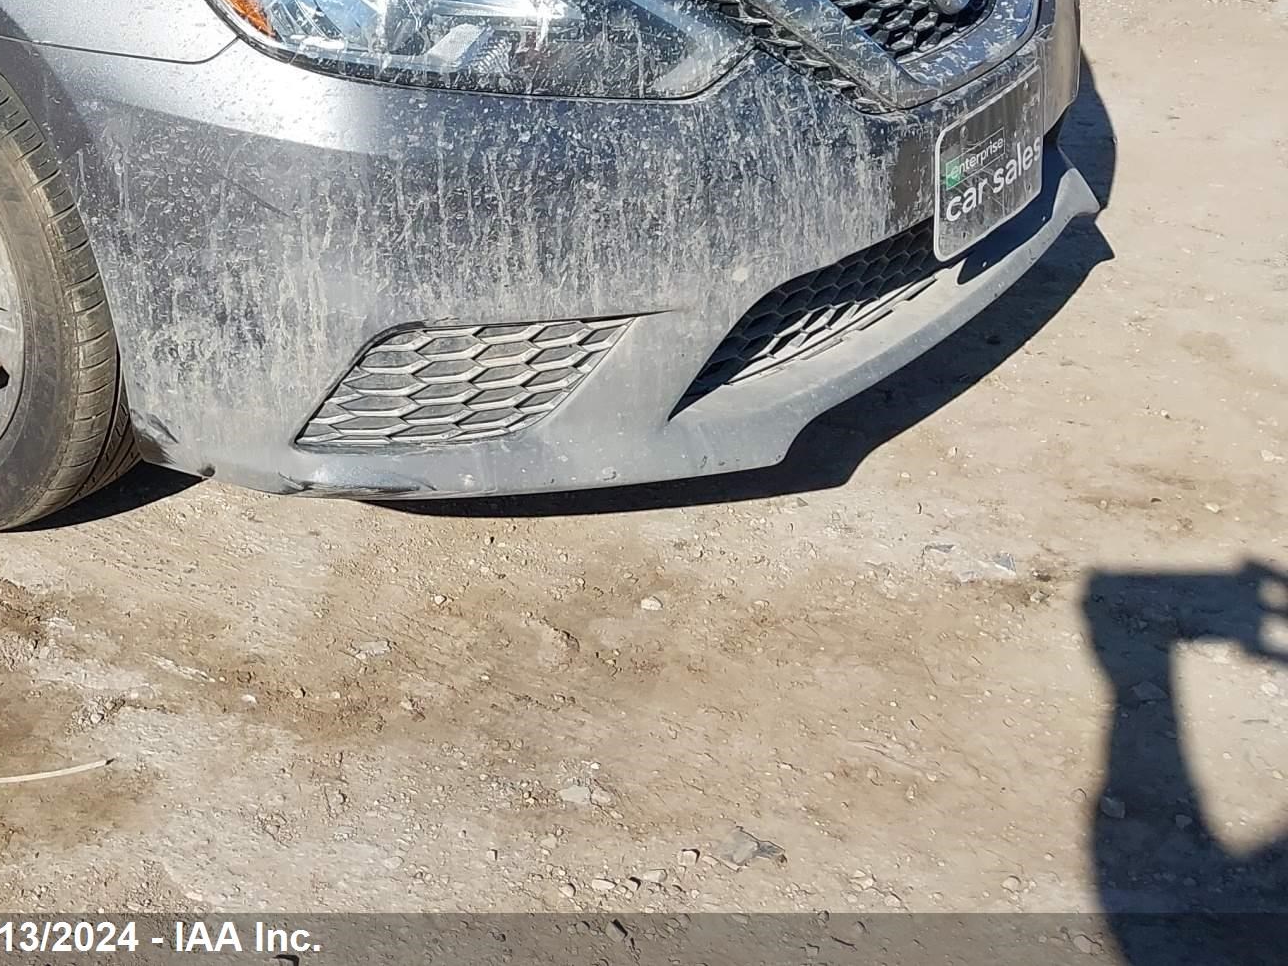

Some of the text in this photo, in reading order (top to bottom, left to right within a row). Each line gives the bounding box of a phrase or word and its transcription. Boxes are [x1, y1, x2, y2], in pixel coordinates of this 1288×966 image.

[945, 135, 1041, 222] car sales
[949, 137, 1004, 180] enterprise
